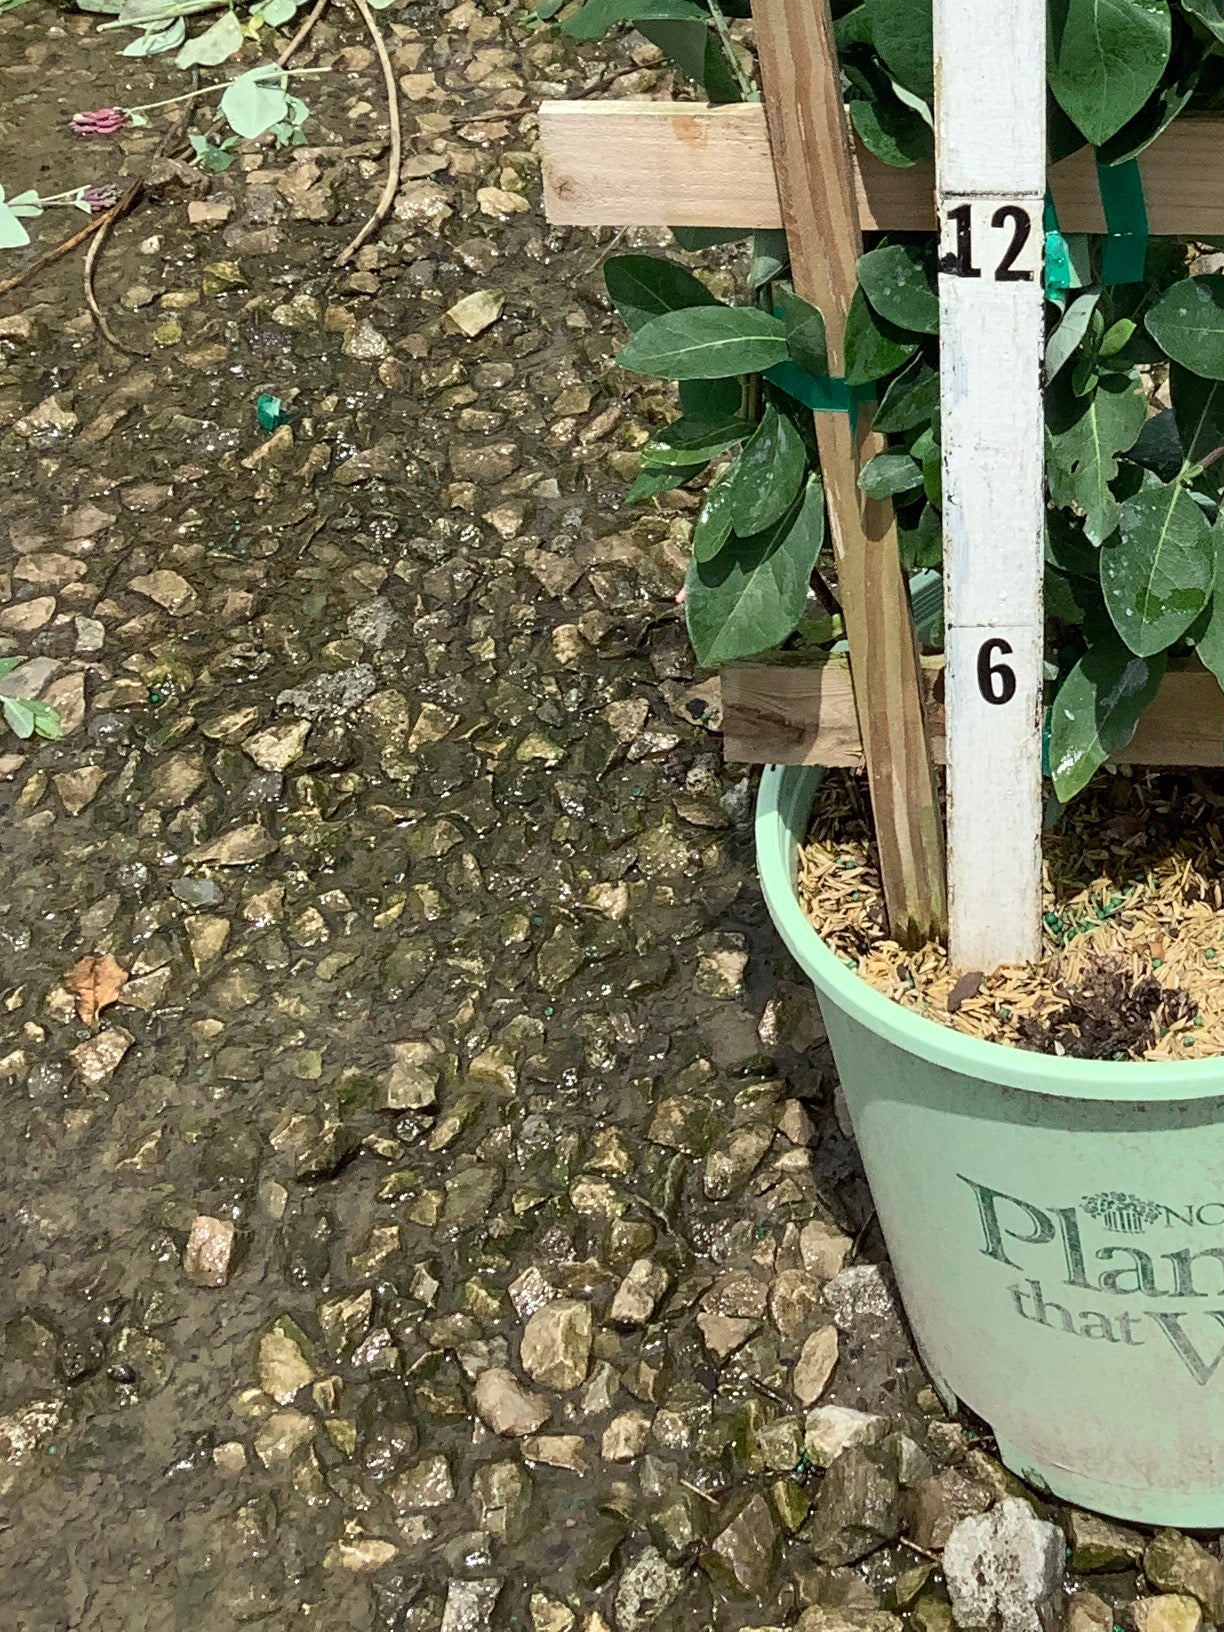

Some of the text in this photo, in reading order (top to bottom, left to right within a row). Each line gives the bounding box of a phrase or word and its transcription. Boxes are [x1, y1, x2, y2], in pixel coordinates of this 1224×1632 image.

[942, 204, 1034, 282] 12
[976, 637, 1017, 706] 6
[1006, 1278, 1146, 1346] that
